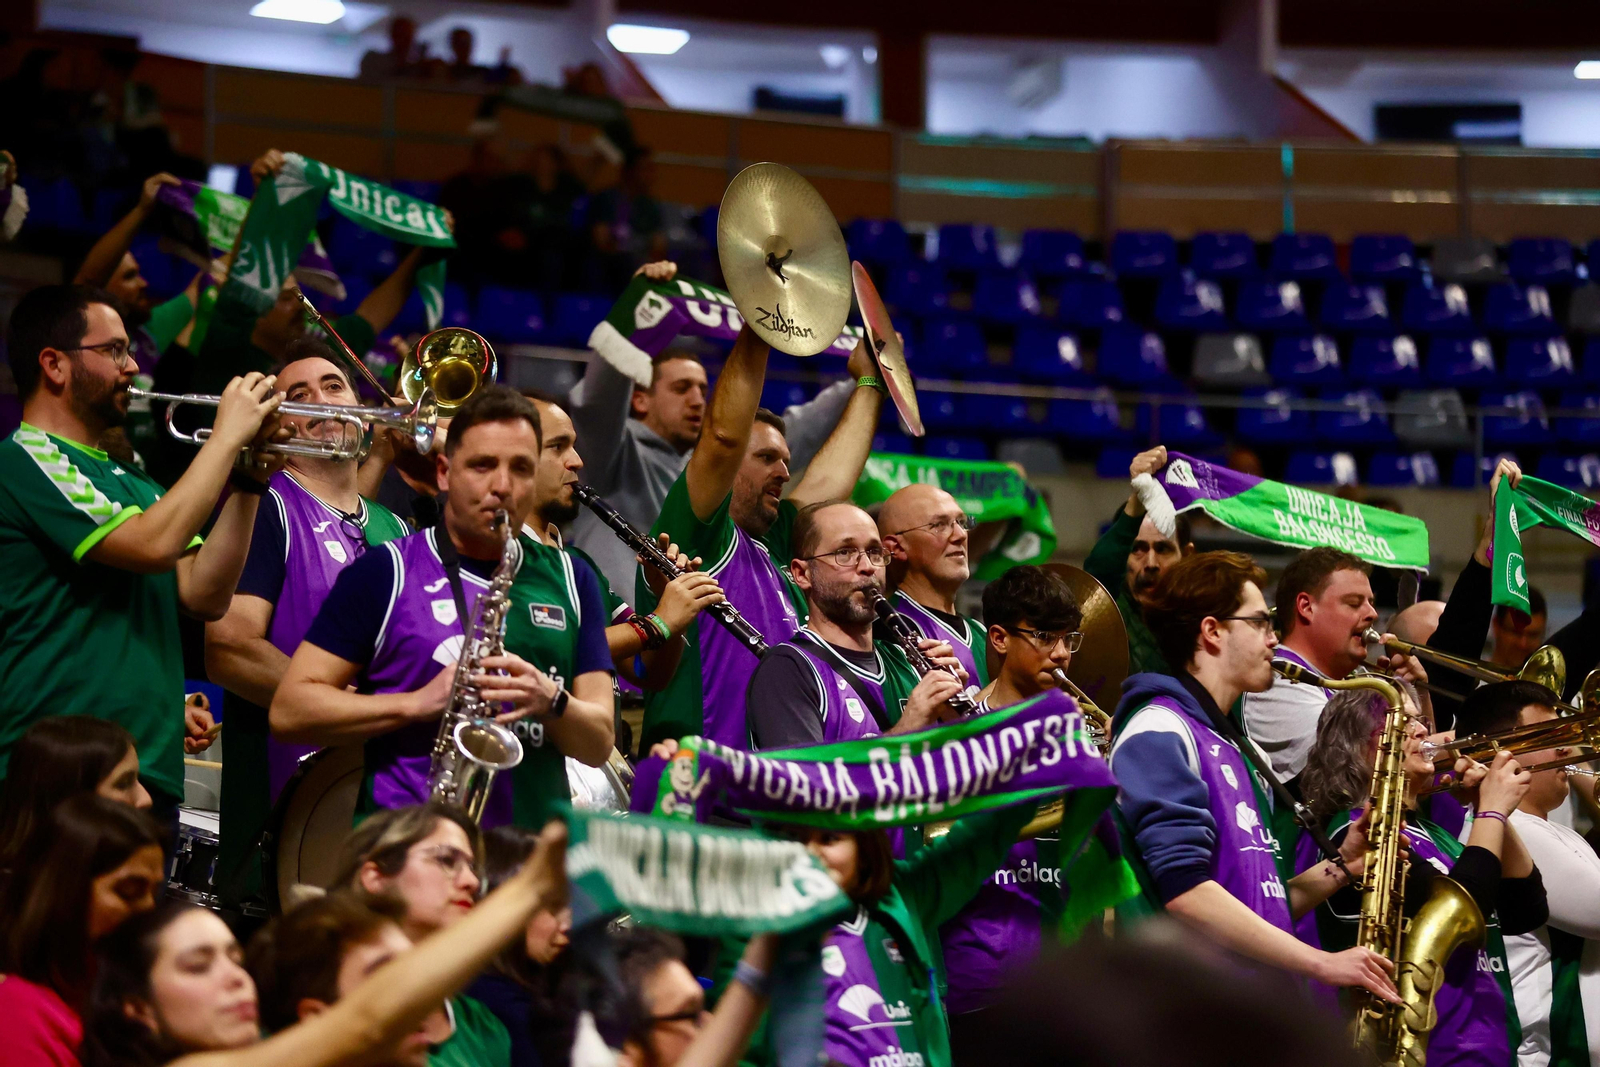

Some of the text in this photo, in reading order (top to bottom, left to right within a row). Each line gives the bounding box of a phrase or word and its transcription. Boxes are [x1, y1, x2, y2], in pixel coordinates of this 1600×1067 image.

[755, 303, 817, 342] Zildjian
[1285, 486, 1367, 532] UNICAJA
[1557, 506, 1587, 527] FINAL
[1273, 509, 1396, 561] BALONCESTO
